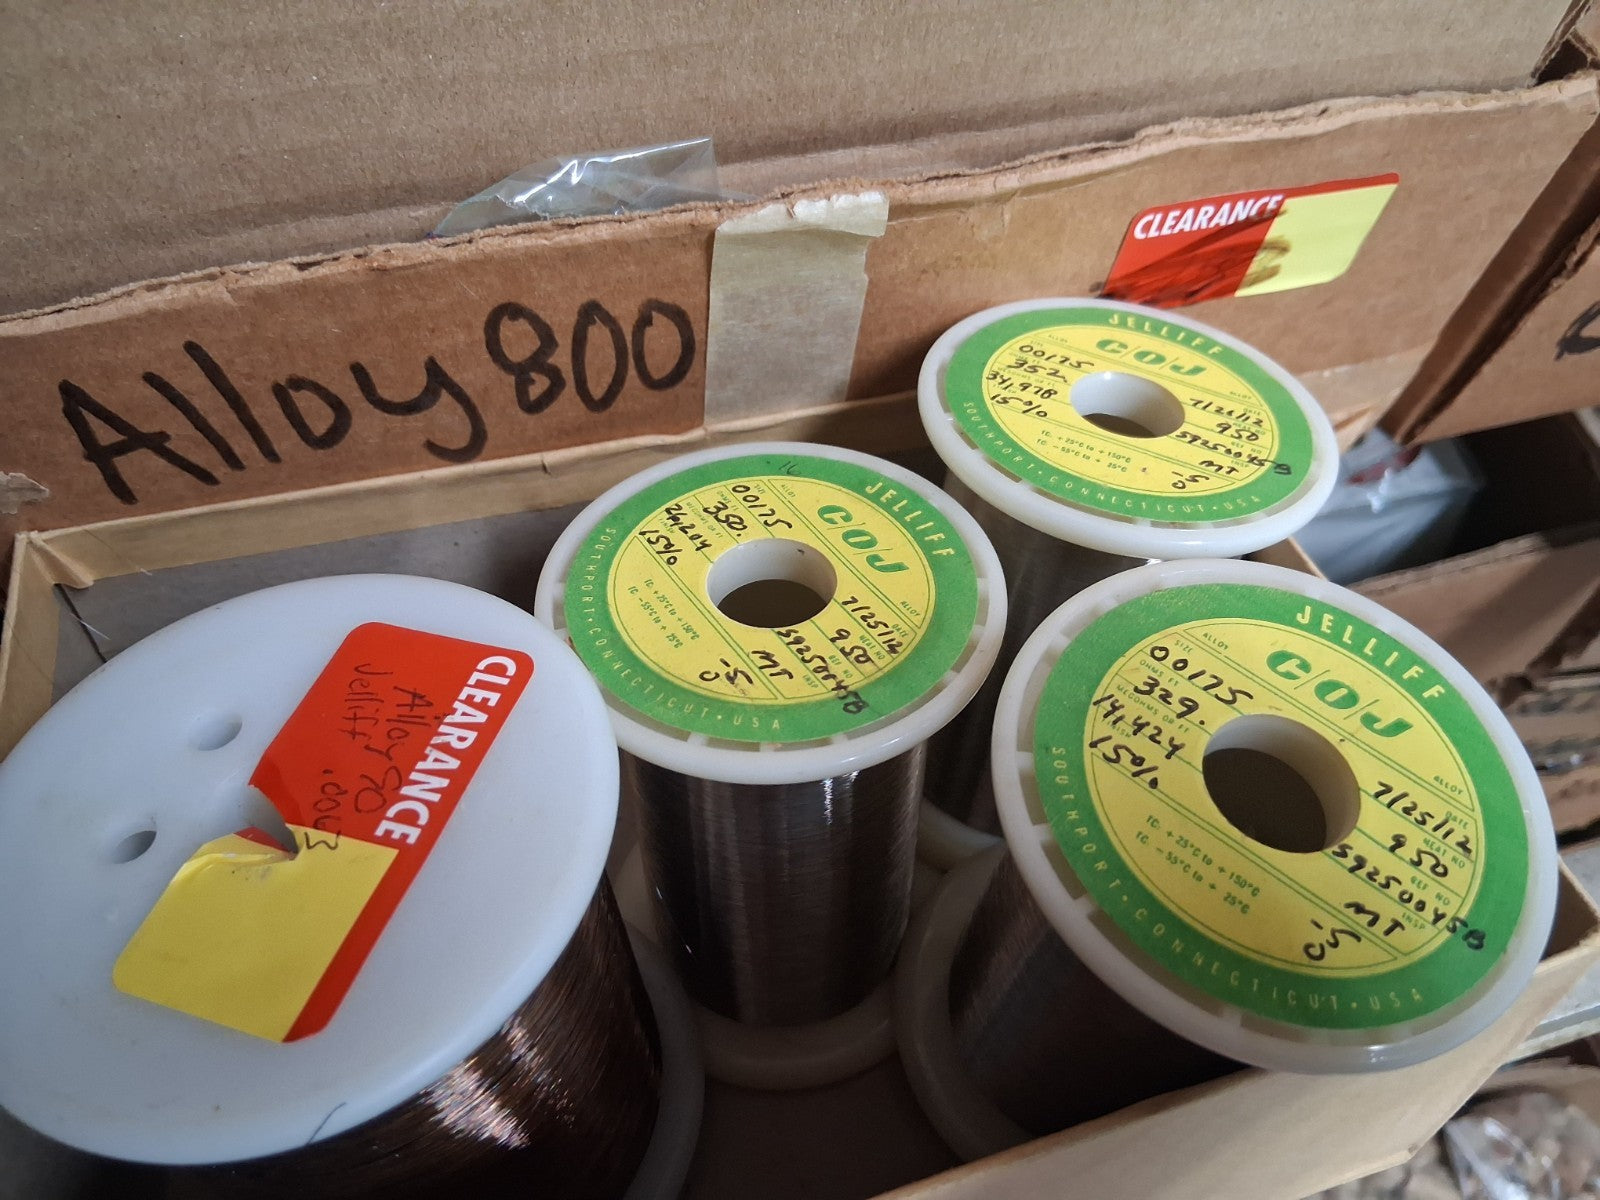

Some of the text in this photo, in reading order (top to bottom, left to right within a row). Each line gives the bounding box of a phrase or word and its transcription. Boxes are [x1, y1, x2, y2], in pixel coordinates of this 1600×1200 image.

[1133, 194, 1283, 240] CLEARANCE
[1019, 344, 1095, 369] 00175
[1109, 313, 1223, 355] JELLIFF
[59, 299, 695, 503] Alloy 800
[1216, 422, 1259, 441] 950
[732, 485, 793, 529] 00175
[865, 482, 956, 557] JELLIFF
[589, 627, 708, 718] CONNECTICUT
[733, 714, 781, 730] USA
[1150, 646, 1254, 705] 00175
[1296, 605, 1446, 699] JELLIFF
[364, 684, 434, 761] Alloy
[374, 655, 517, 845] CLEARANCE
[1374, 781, 1472, 856] 7/25/12
[1388, 833, 1449, 878] 950
[1135, 908, 1338, 1010] CONNECTICUT
[1370, 988, 1423, 1011] USA
